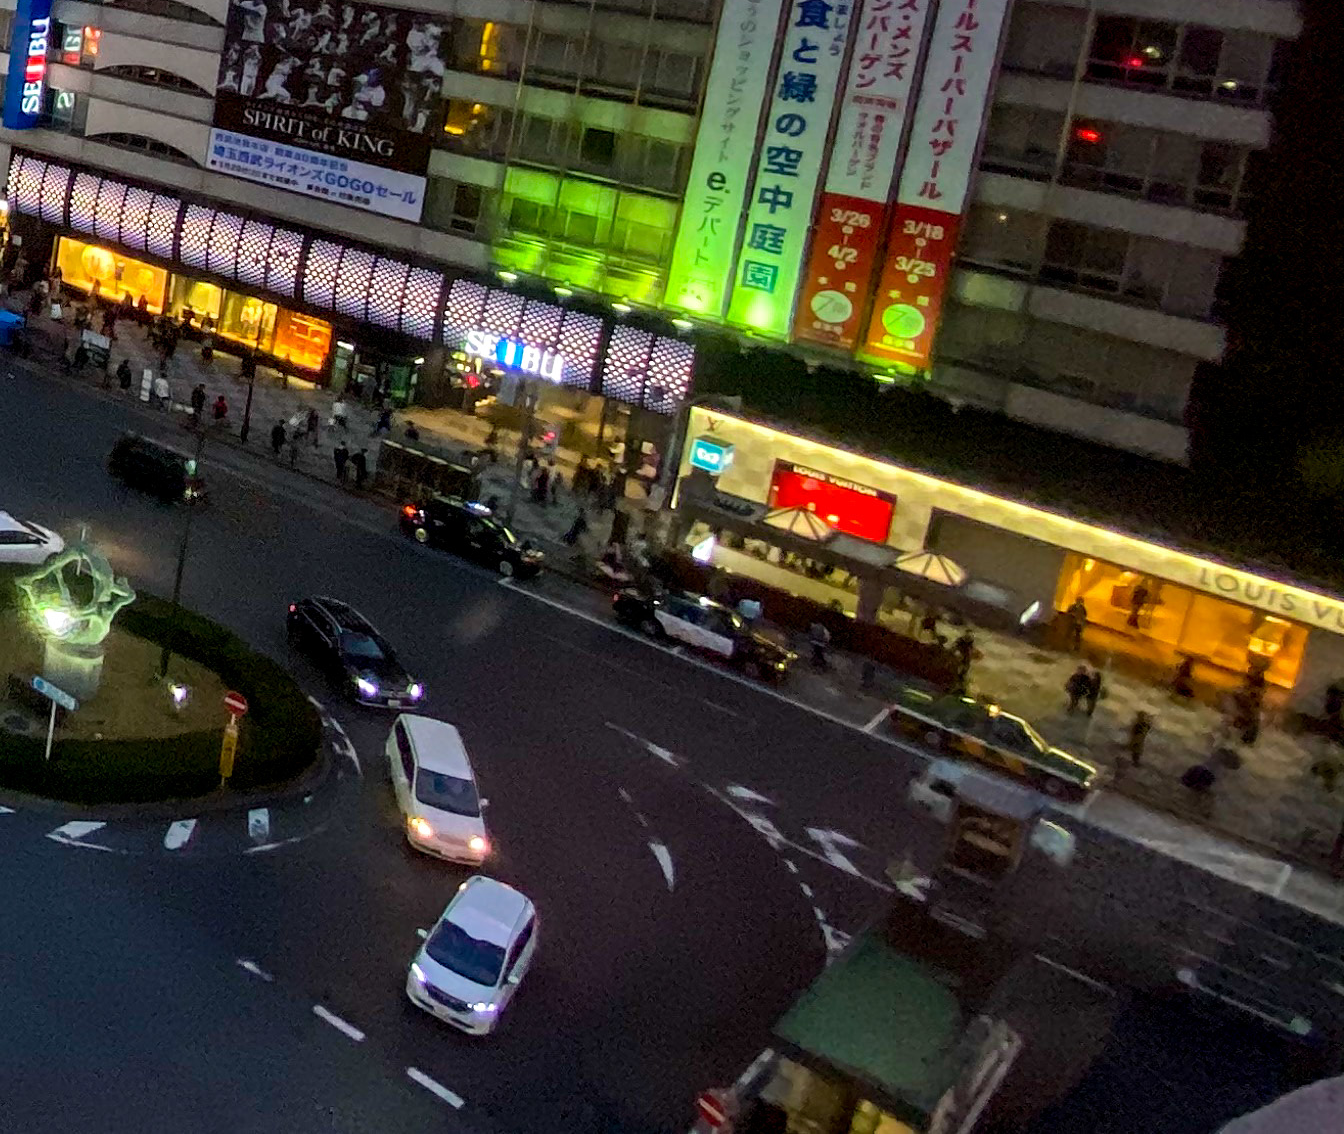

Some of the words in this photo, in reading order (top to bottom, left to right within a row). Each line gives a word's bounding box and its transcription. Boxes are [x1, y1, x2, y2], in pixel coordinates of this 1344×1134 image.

[21, 16, 50, 114] SEIBU
[243, 109, 309, 137] SPIRIT
[312, 127, 329, 142] of
[337, 130, 395, 157] KING
[827, 244, 858, 263] 4/2
[465, 330, 564, 383] SEIBU
[1200, 567, 1296, 611] LOUIS
